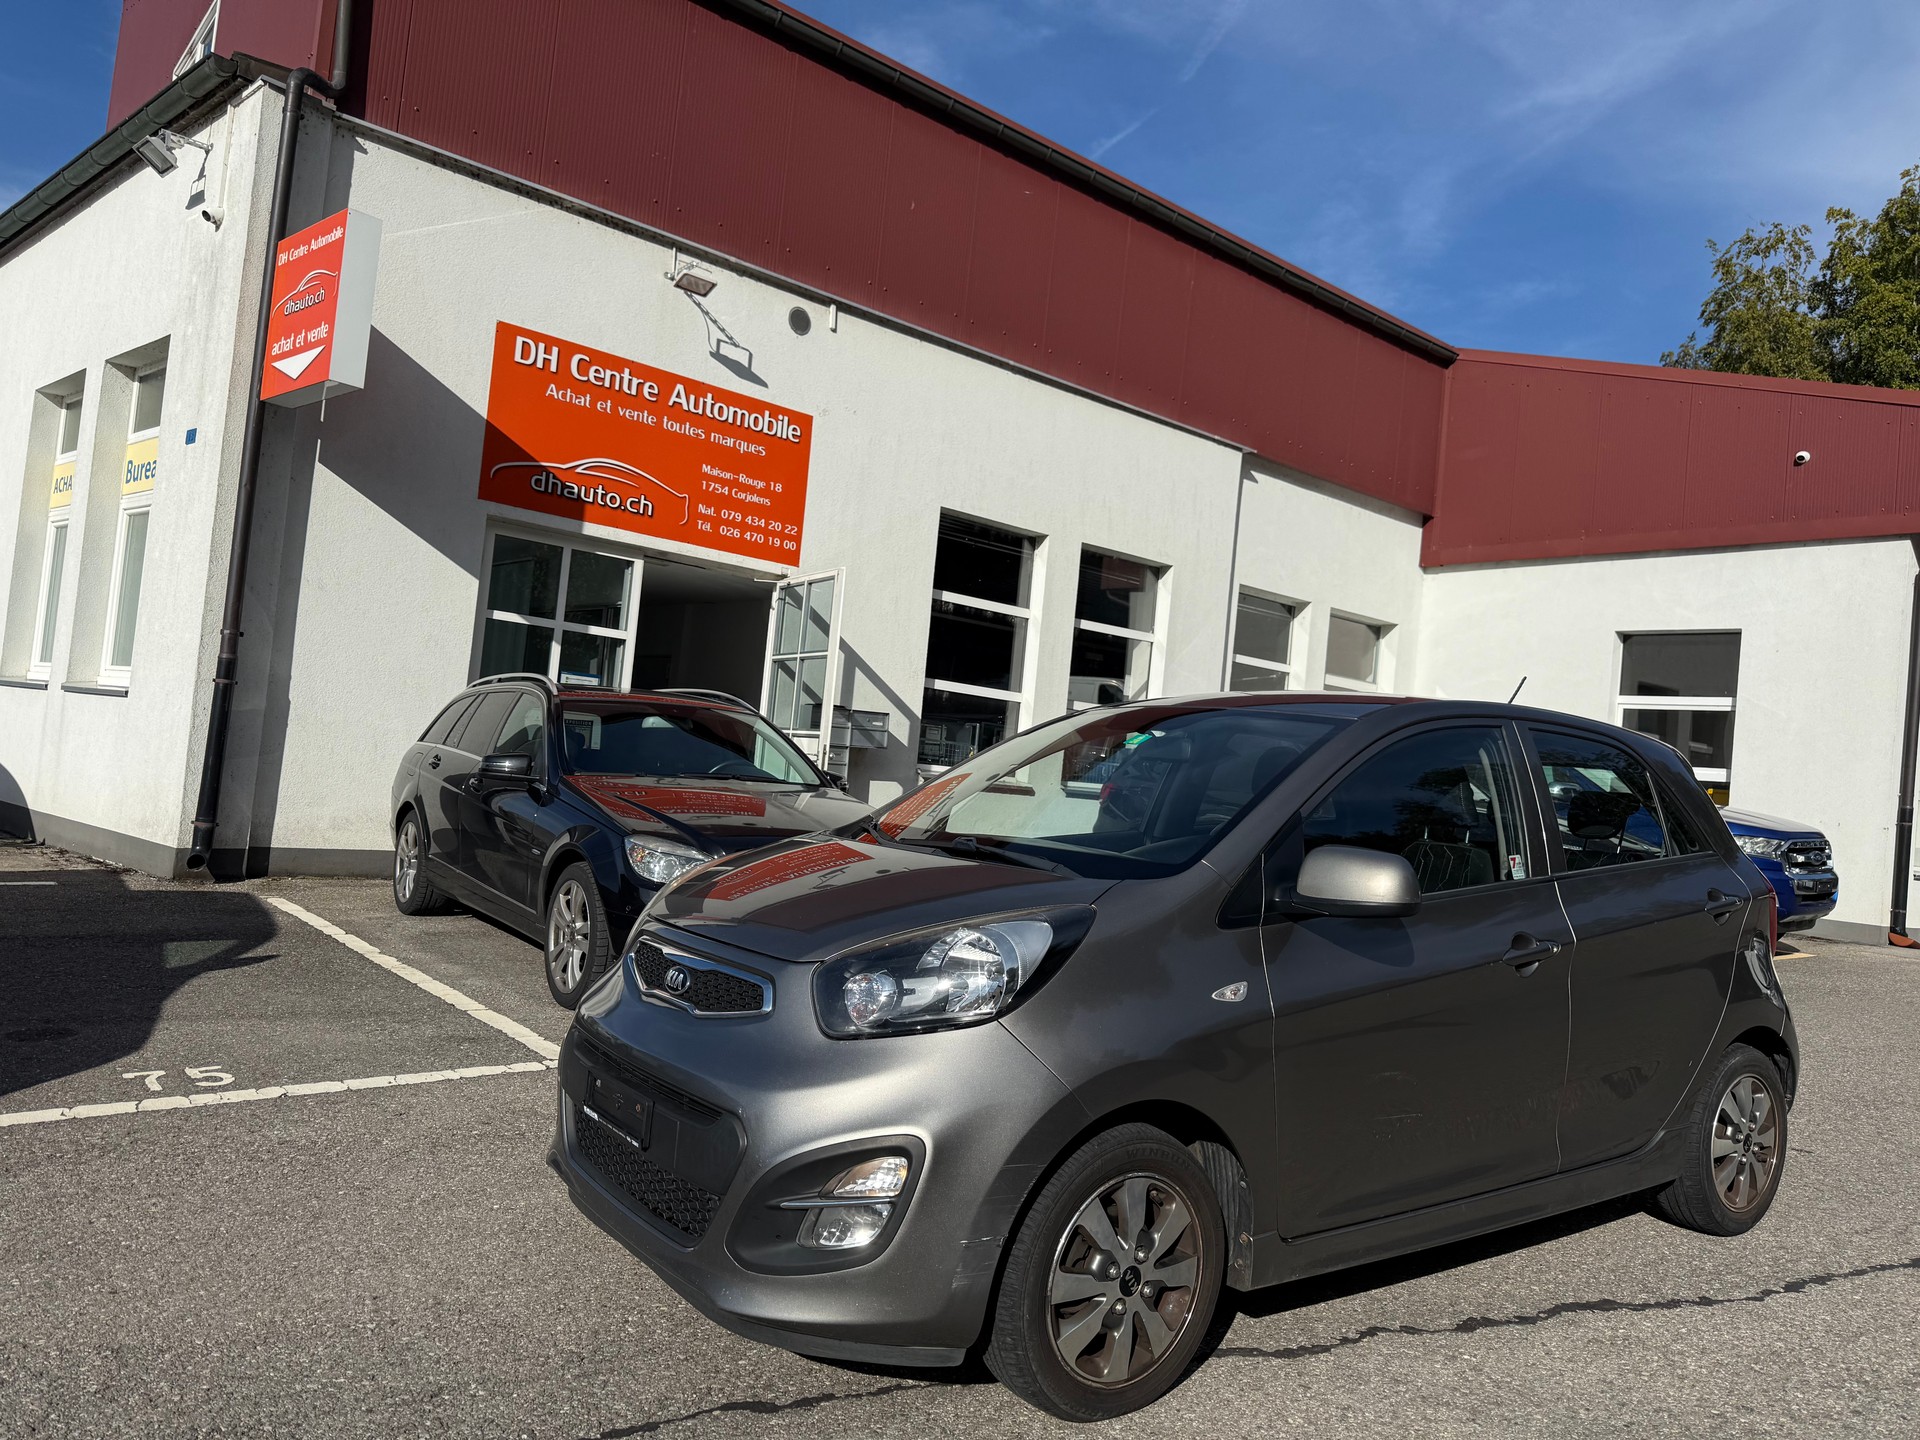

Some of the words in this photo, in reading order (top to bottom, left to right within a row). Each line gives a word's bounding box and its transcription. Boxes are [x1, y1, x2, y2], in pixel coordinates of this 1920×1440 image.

[278, 253, 287, 266] DH
[289, 244, 308, 261] Centre
[310, 226, 344, 251] Automobile
[284, 286, 325, 315] dhauto.ch
[272, 333, 294, 356] achat
[296, 329, 305, 348] et
[307, 321, 329, 343] vente
[514, 336, 559, 373] DH
[570, 354, 658, 401] Centre
[668, 383, 801, 442] Automobile
[546, 384, 591, 408] Achat
[597, 400, 612, 414] et
[618, 406, 656, 426] vente
[663, 416, 705, 440] toutes
[710, 432, 766, 456] marques
[53, 475, 74, 494] ACHA
[702, 464, 766, 489] Maison-Rouge
[770, 482, 782, 492] 18
[530, 471, 654, 517] dhauto.ch
[702, 480, 728, 496] 1754
[732, 488, 770, 506] Corjolens
[698, 504, 716, 517] Nat.
[721, 510, 742, 522] 079
[745, 516, 765, 528] 434
[768, 520, 782, 531] 20
[784, 524, 798, 536] 22
[697, 520, 712, 532] Tél.
[720, 526, 740, 538] 026
[744, 532, 764, 544] 470
[768, 536, 780, 547] 19
[784, 540, 796, 550] 00
[666, 970, 684, 990] KIA
[122, 1066, 236, 1091] 75
[1125, 1270, 1138, 1294] KIA
